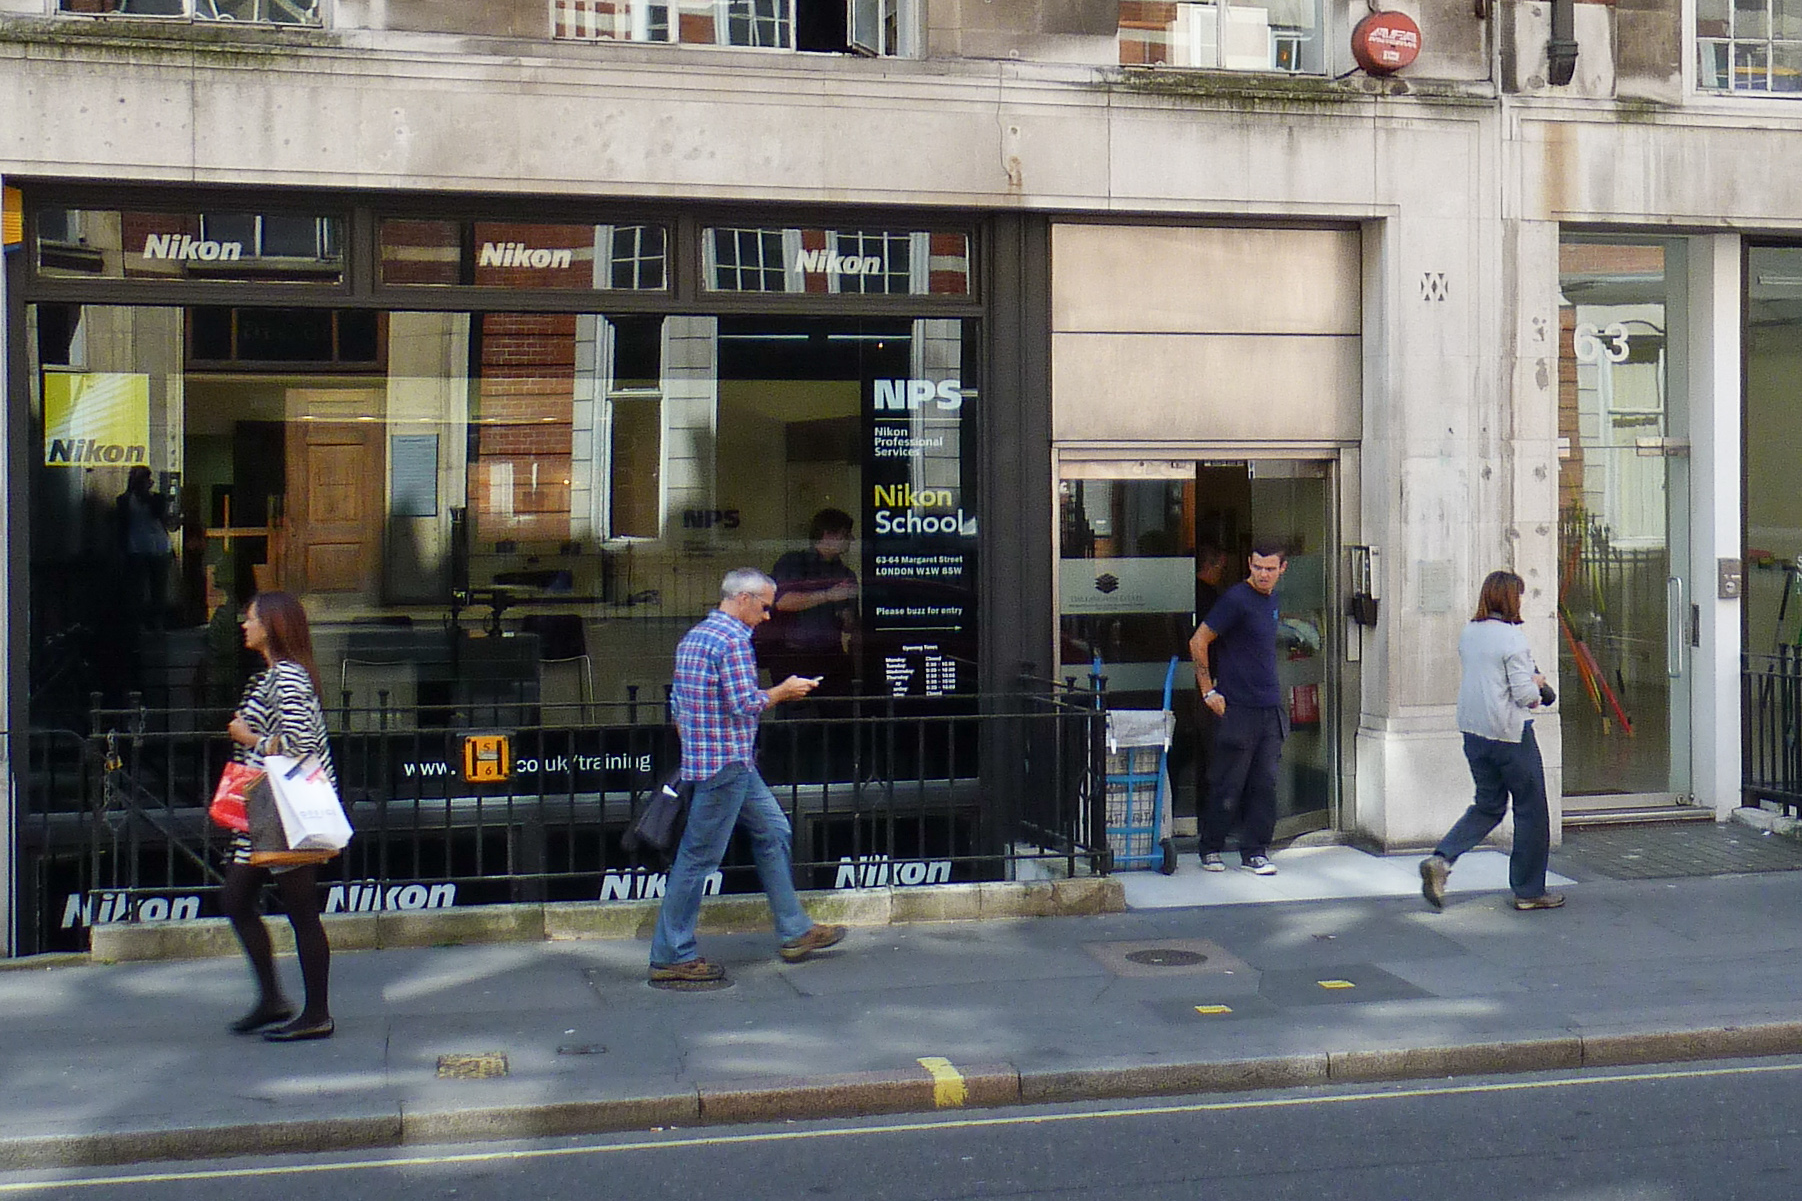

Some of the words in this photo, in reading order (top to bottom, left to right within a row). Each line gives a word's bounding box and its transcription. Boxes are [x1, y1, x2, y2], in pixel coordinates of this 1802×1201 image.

[142, 233, 242, 261] Nikon
[479, 242, 572, 268] Nikon
[795, 249, 881, 274] Nikon
[1574, 322, 1630, 362] 63
[874, 379, 962, 410] NPS
[874, 426, 908, 436] Nikon
[874, 436, 943, 447] Professional
[48, 439, 146, 463] Nikon
[874, 446, 920, 457] Services
[874, 483, 952, 507] Nikon
[875, 508, 963, 534] School
[875, 556, 900, 564] 63-64
[901, 556, 937, 565] Margaret
[875, 568, 914, 576] LONDON
[915, 567, 940, 575] W1W
[876, 607, 905, 615] Please
[906, 607, 926, 615] buzz
[940, 606, 963, 615] entry
[485, 766, 492, 775] 6
[834, 854, 953, 889] Nikon
[325, 878, 457, 913] Nikon
[600, 867, 723, 901] Nikn
